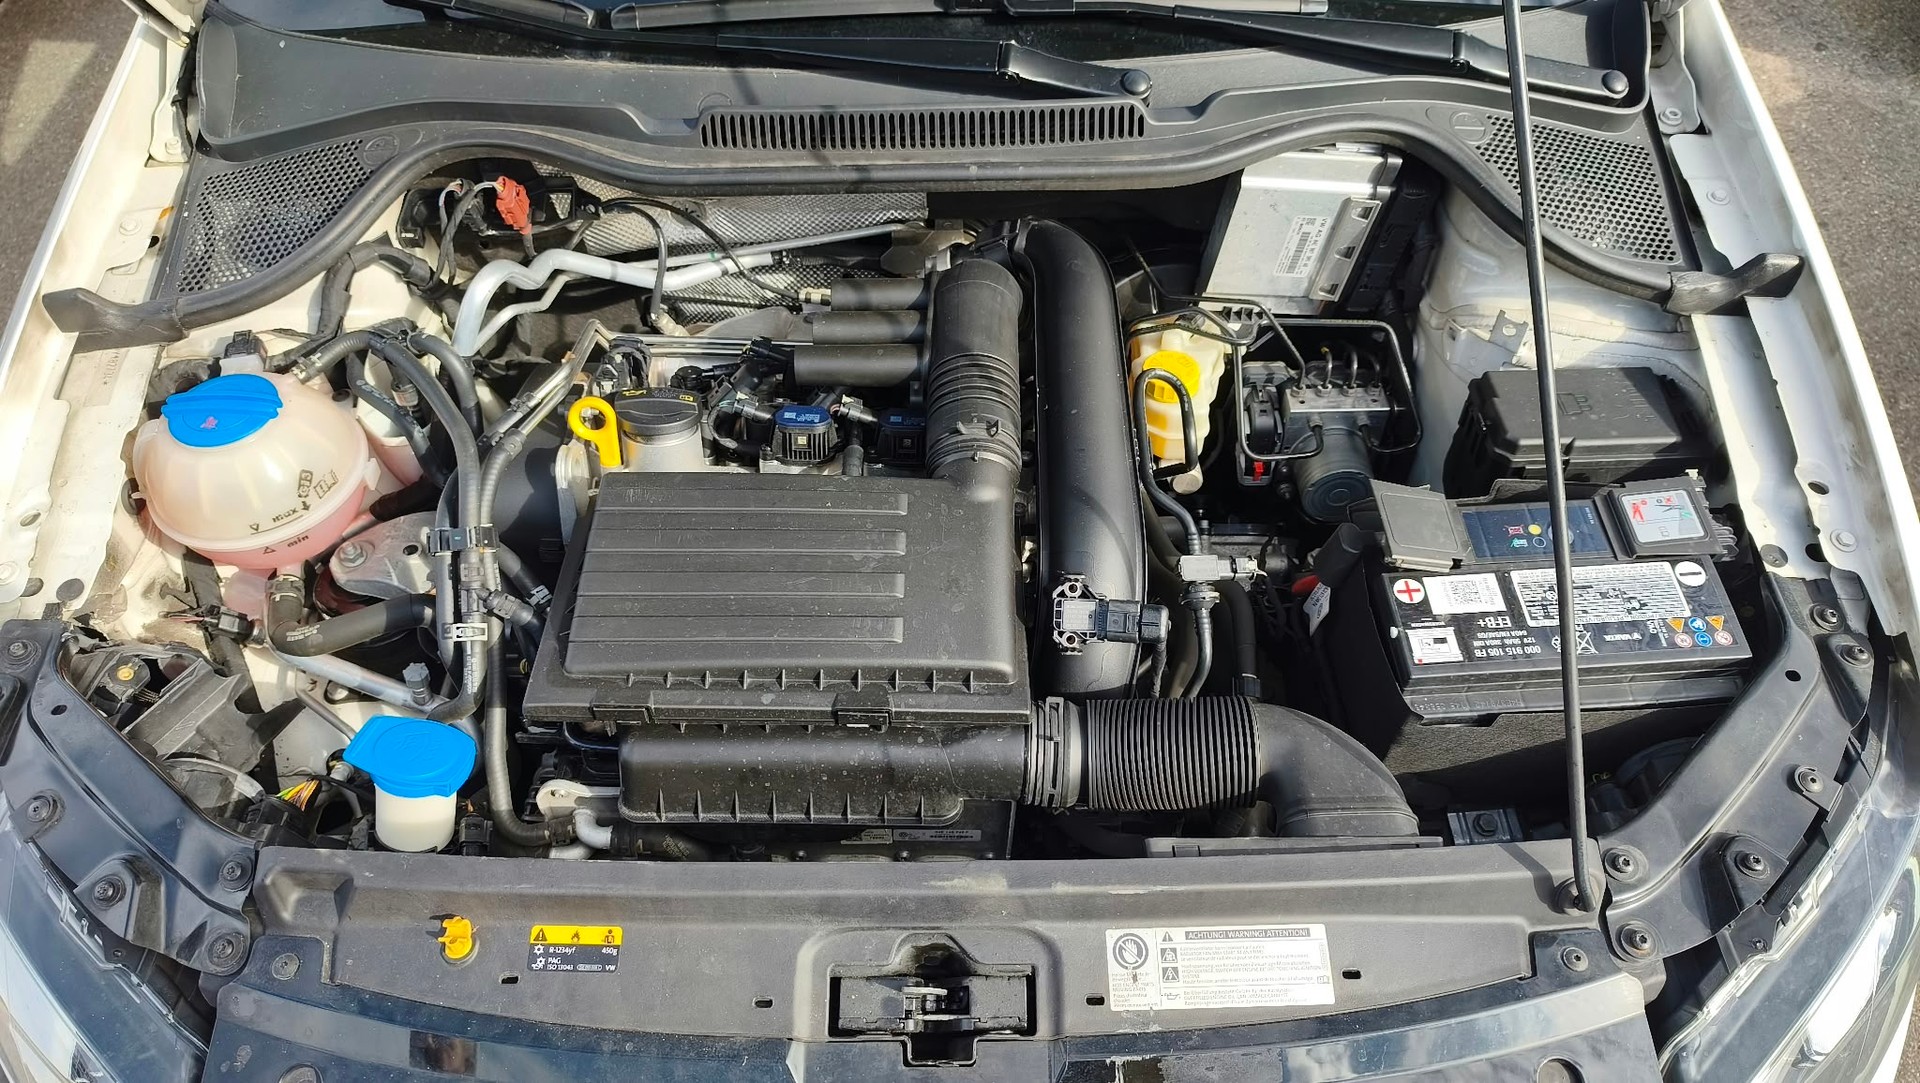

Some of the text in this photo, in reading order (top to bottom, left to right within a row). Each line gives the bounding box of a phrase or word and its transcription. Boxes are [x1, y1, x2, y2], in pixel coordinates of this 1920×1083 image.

[272, 508, 298, 521] max
[288, 536, 309, 547] min
[1477, 616, 1512, 629] EFB+
[1474, 645, 1541, 657] 000 915 105 FB
[1188, 928, 1308, 939] ACHTUNG! WARNING! ATTENTION!
[549, 946, 618, 956] R-1234yf 450g
